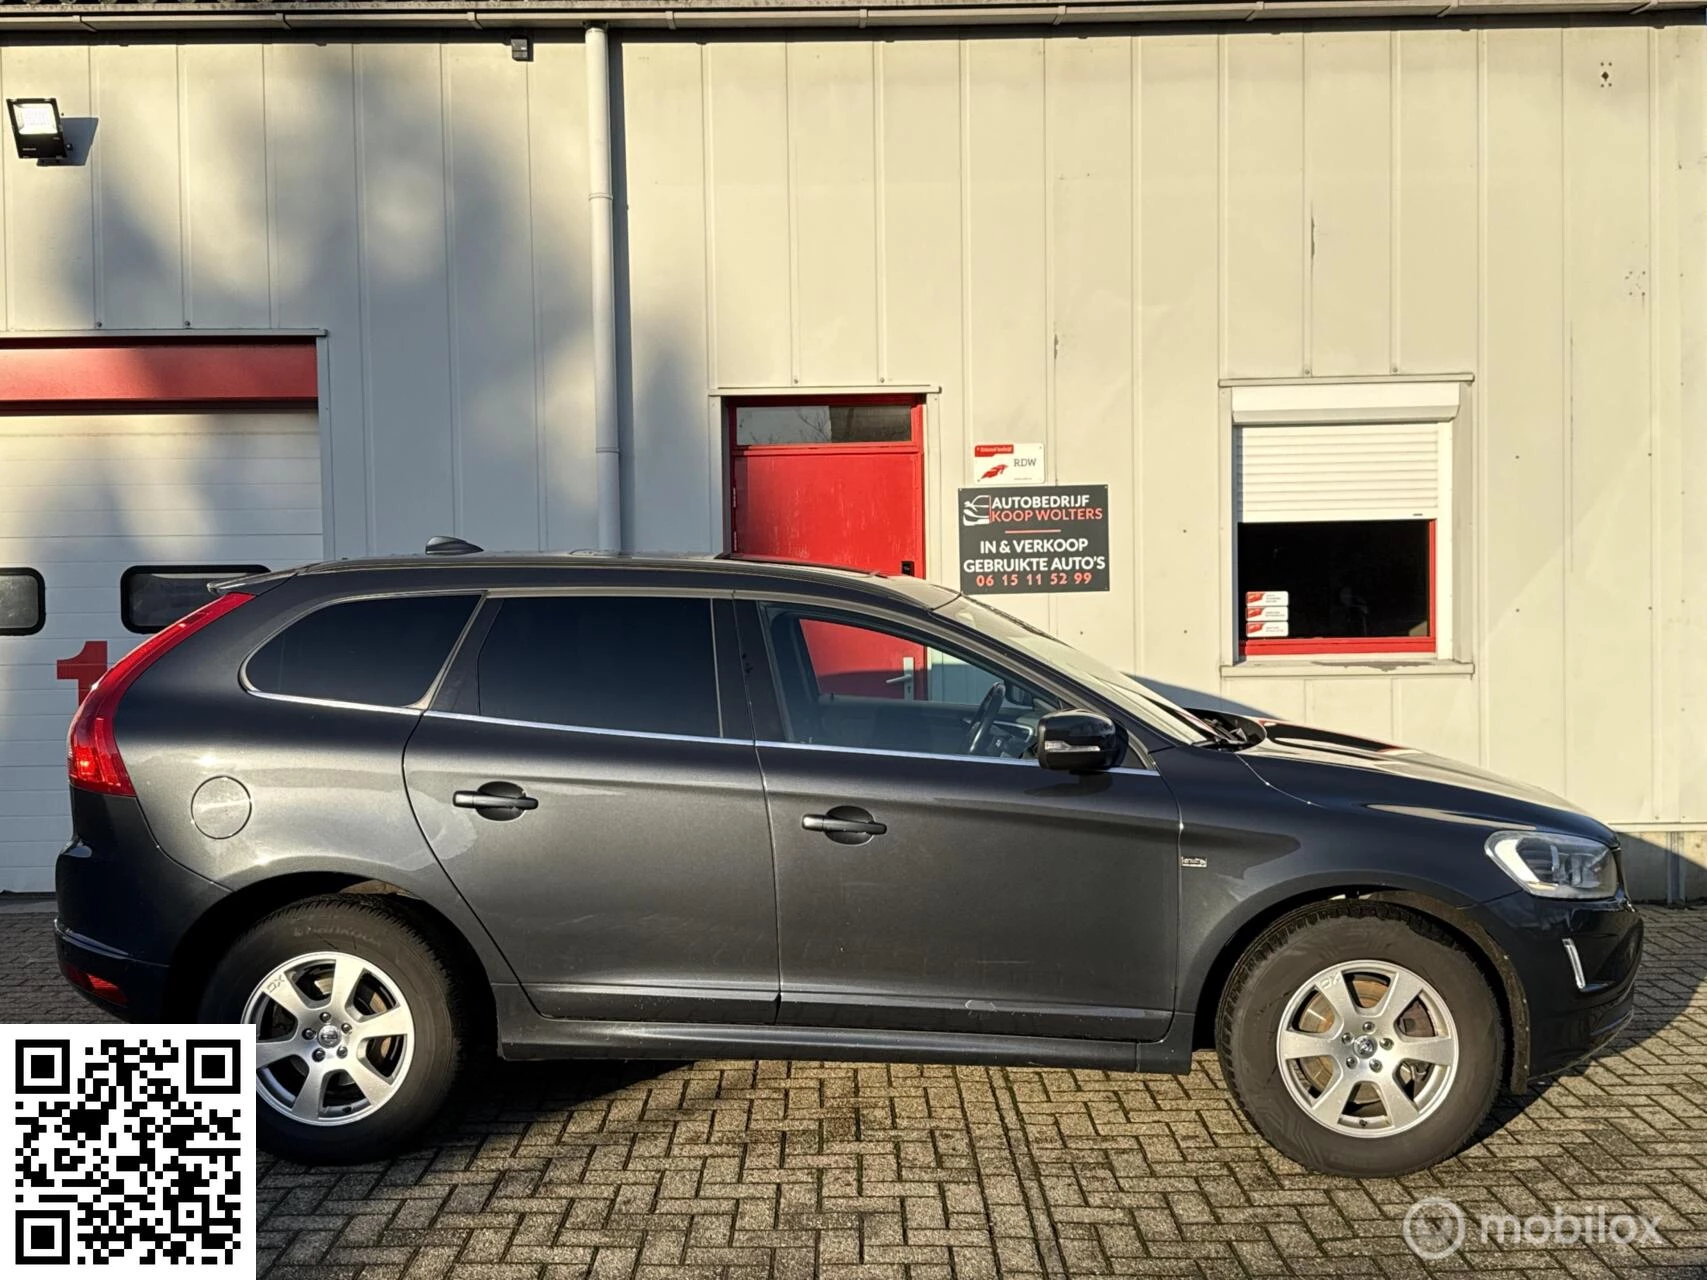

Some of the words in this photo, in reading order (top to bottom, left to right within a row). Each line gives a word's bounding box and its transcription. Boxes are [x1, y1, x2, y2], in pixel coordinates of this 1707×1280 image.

[1013, 458, 1037, 467] RDW
[991, 494, 1090, 509] AUTOBEDRIJF
[991, 510, 1033, 522] KOOP
[1035, 508, 1103, 521] WOLTERS
[980, 540, 997, 554] IN
[999, 540, 1011, 553] &
[1013, 538, 1089, 553] VERKOOP
[963, 558, 1049, 573] GEBRUIKTE
[1051, 556, 1106, 571] AUTO'S
[976, 574, 994, 587] 06
[1002, 574, 1019, 586] 15
[1026, 573, 1042, 585] 11
[1050, 573, 1068, 585] 52
[1073, 572, 1092, 584] 99
[57, 640, 108, 706] 1
